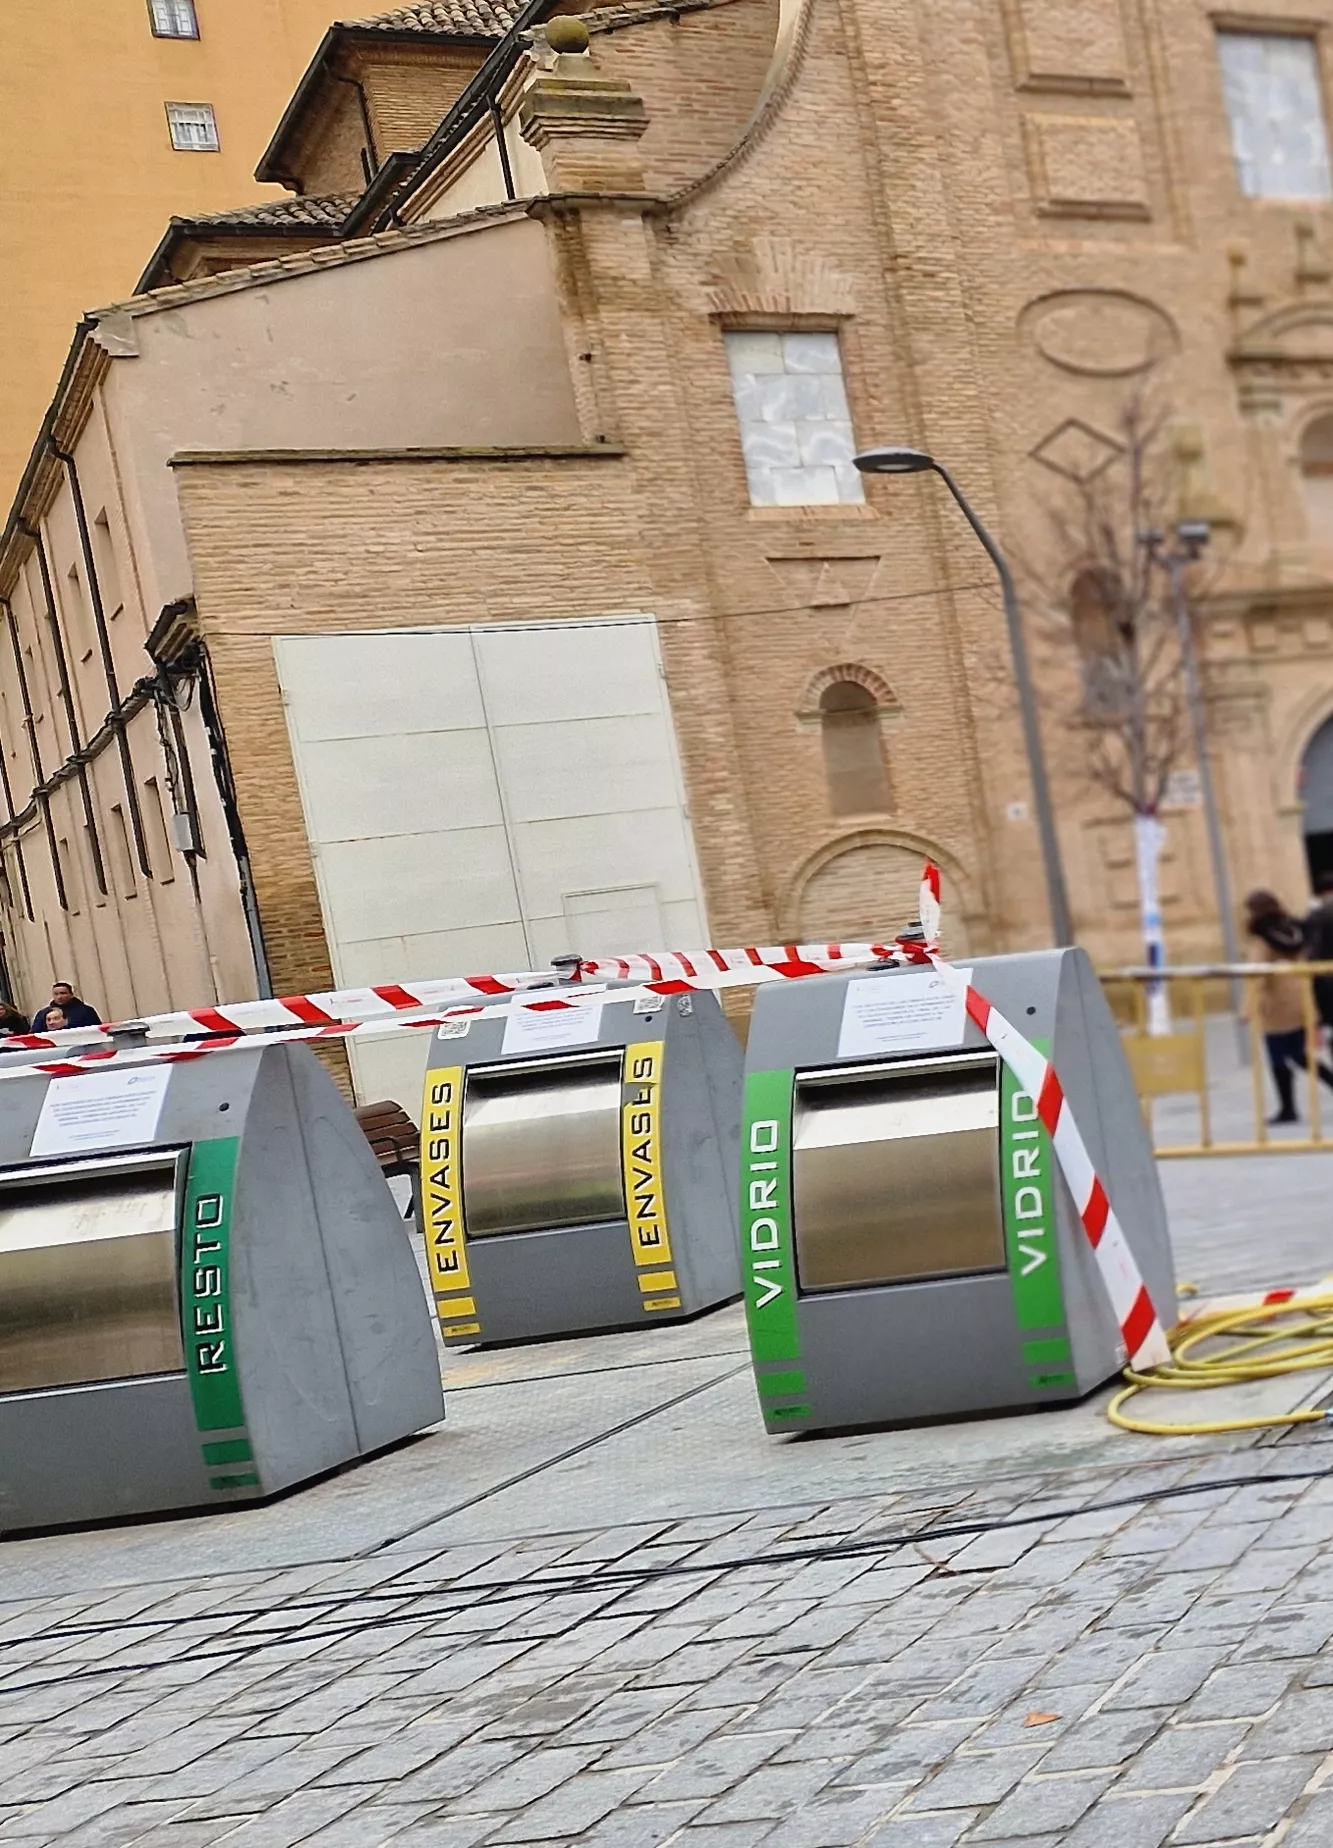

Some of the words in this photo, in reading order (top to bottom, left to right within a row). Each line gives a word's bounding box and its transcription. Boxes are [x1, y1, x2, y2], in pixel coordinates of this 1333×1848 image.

[429, 1082, 460, 1274] ENVASES
[629, 1057, 661, 1248] ENVASES
[749, 1119, 784, 1309] VIDRIO
[1011, 1090, 1048, 1277] VIDRIO
[193, 1191, 228, 1375] RESTO
